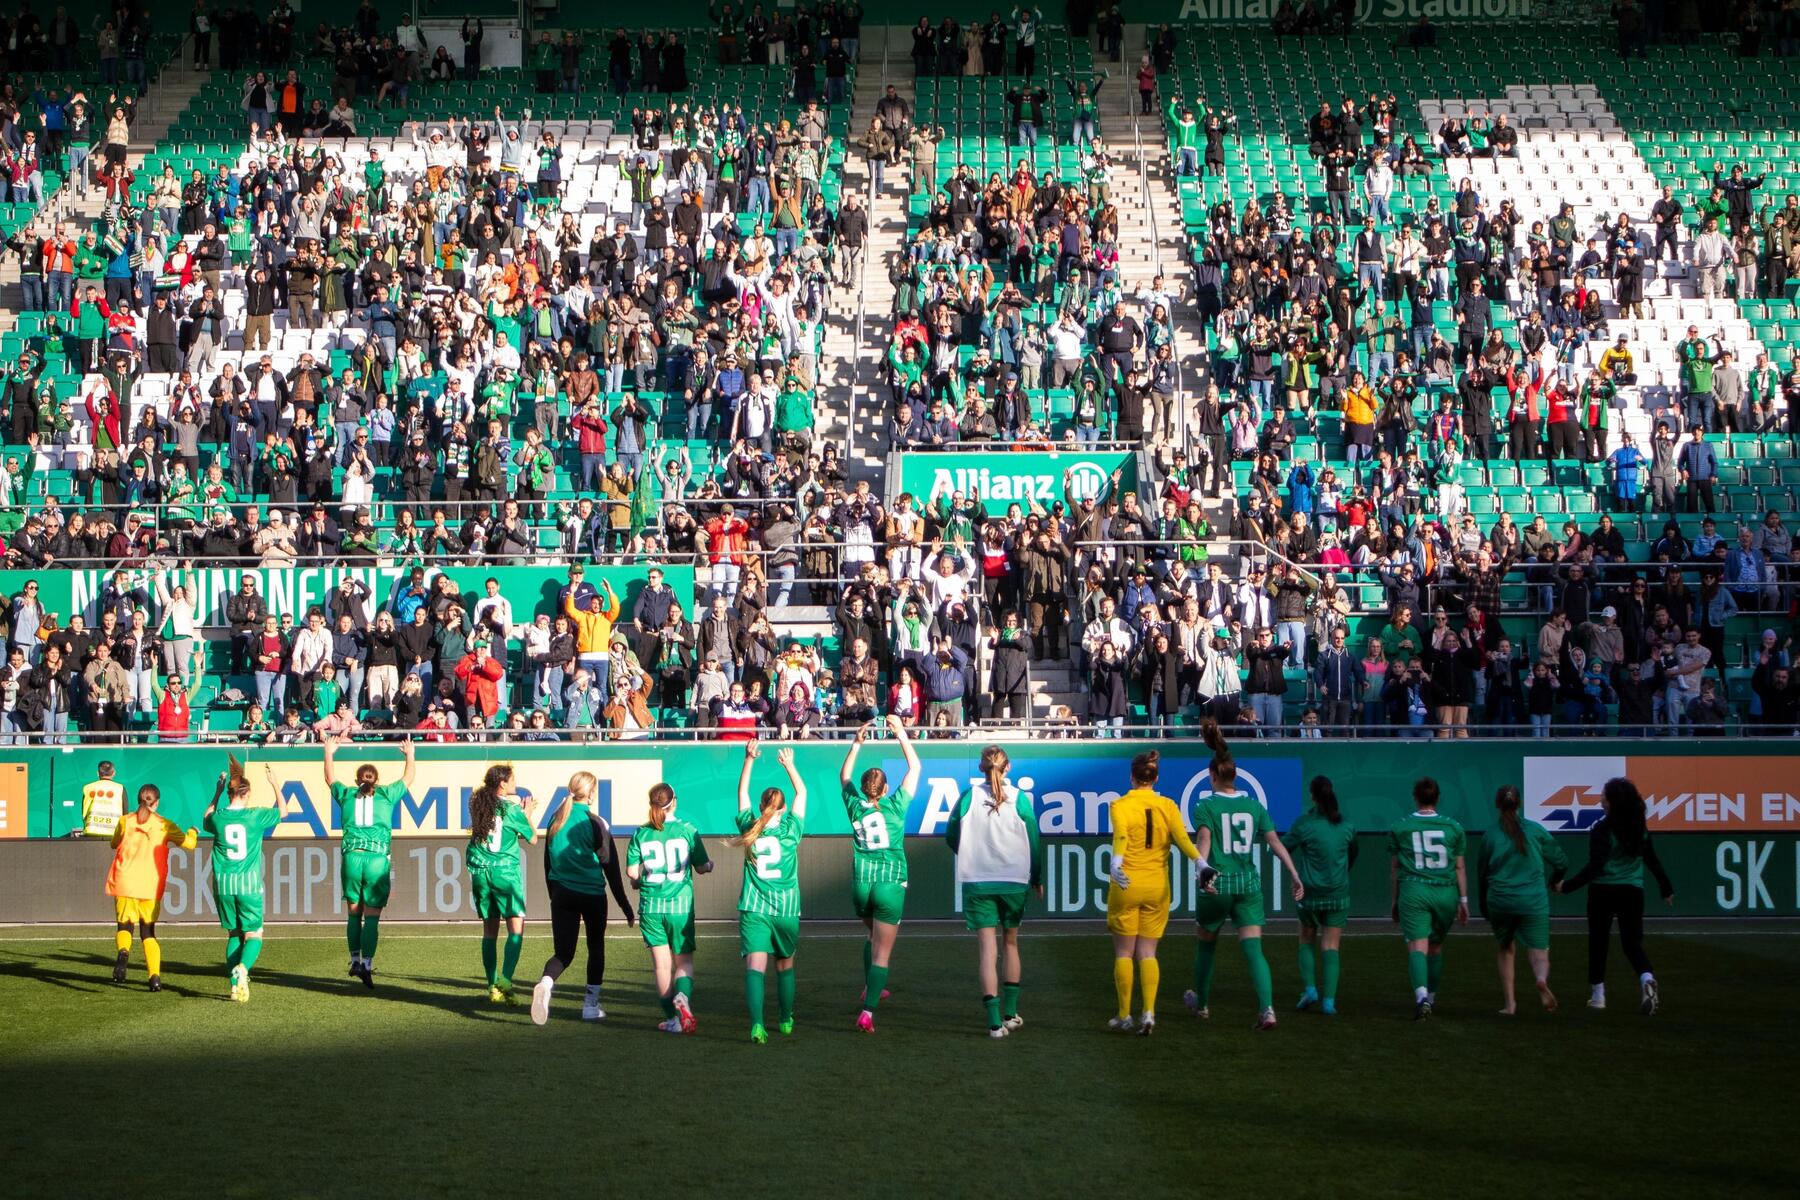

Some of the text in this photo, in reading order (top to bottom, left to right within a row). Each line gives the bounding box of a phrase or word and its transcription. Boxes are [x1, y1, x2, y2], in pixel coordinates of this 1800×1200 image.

[929, 468, 1054, 500] Allianz
[1645, 793, 1746, 821] WIEN
[225, 823, 247, 860] 9
[1145, 808, 1153, 849] 1
[1221, 812, 1254, 854] 13
[640, 838, 690, 883] 20
[755, 836, 782, 879] 2
[1412, 830, 1448, 869] 15
[163, 847, 217, 915] SK
[1716, 840, 1776, 909] SK
